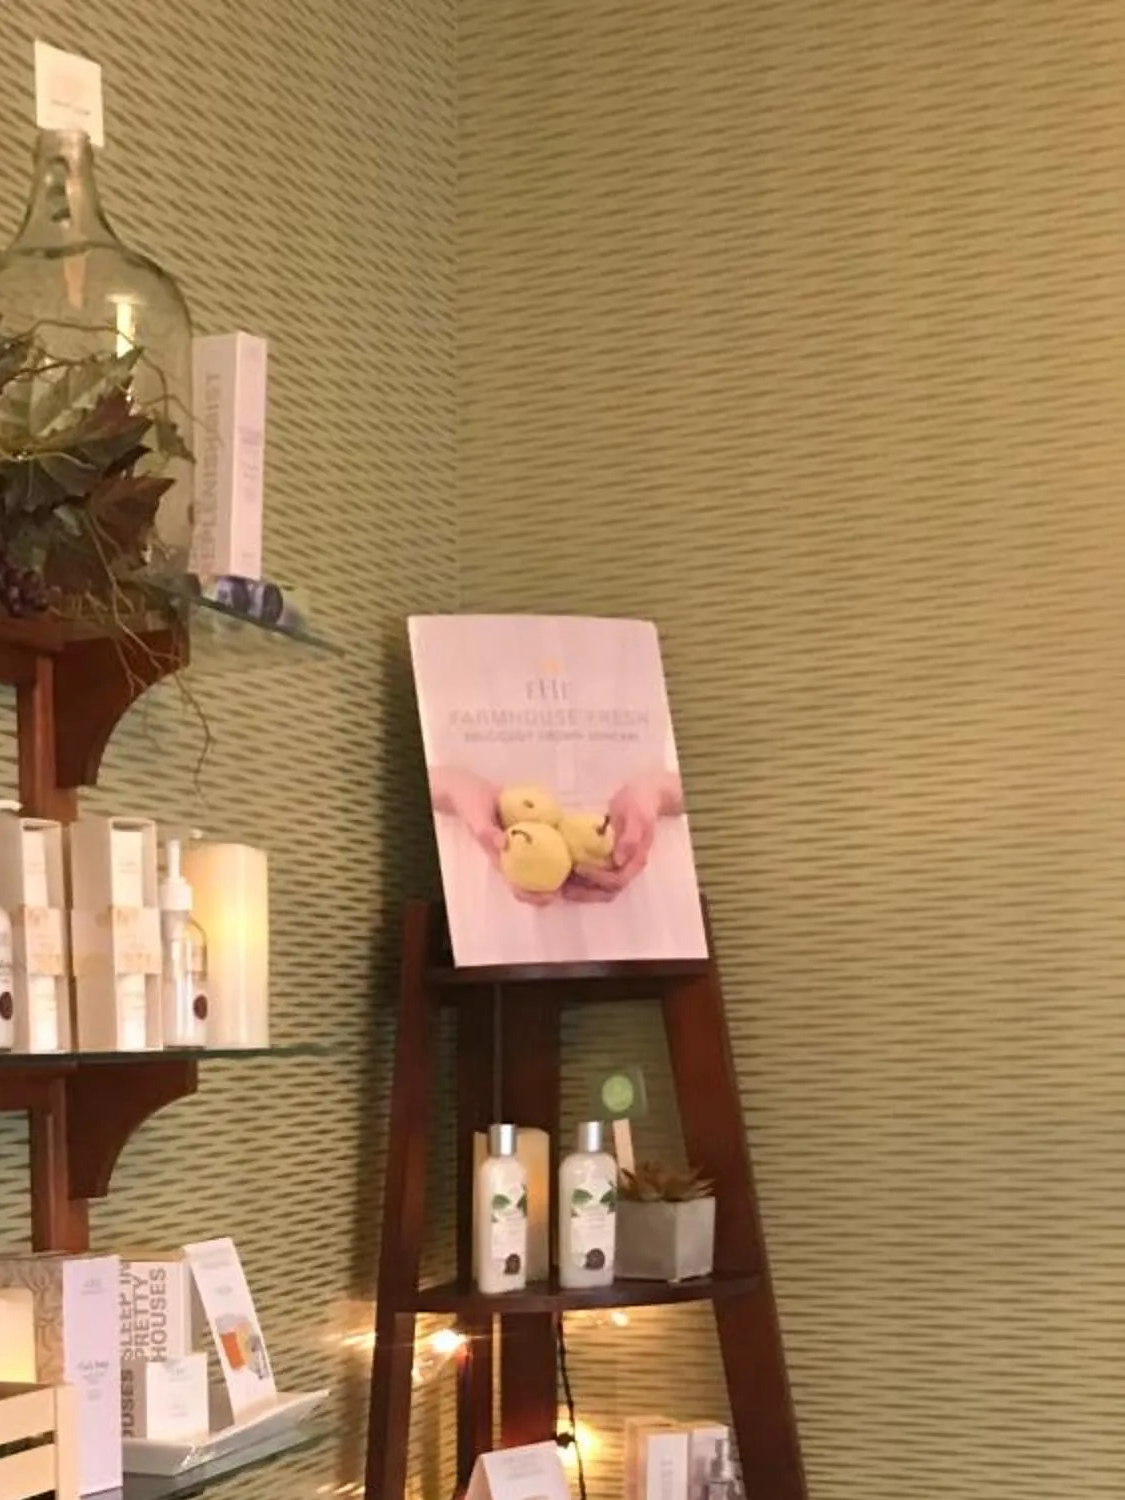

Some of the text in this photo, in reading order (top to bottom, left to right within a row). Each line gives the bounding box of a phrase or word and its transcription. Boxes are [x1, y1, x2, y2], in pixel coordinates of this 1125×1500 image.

[449, 708, 650, 728] FARMHOUSE FRESH
[133, 1275, 149, 1361] PRETTY
[149, 1267, 166, 1363] HOUSES
